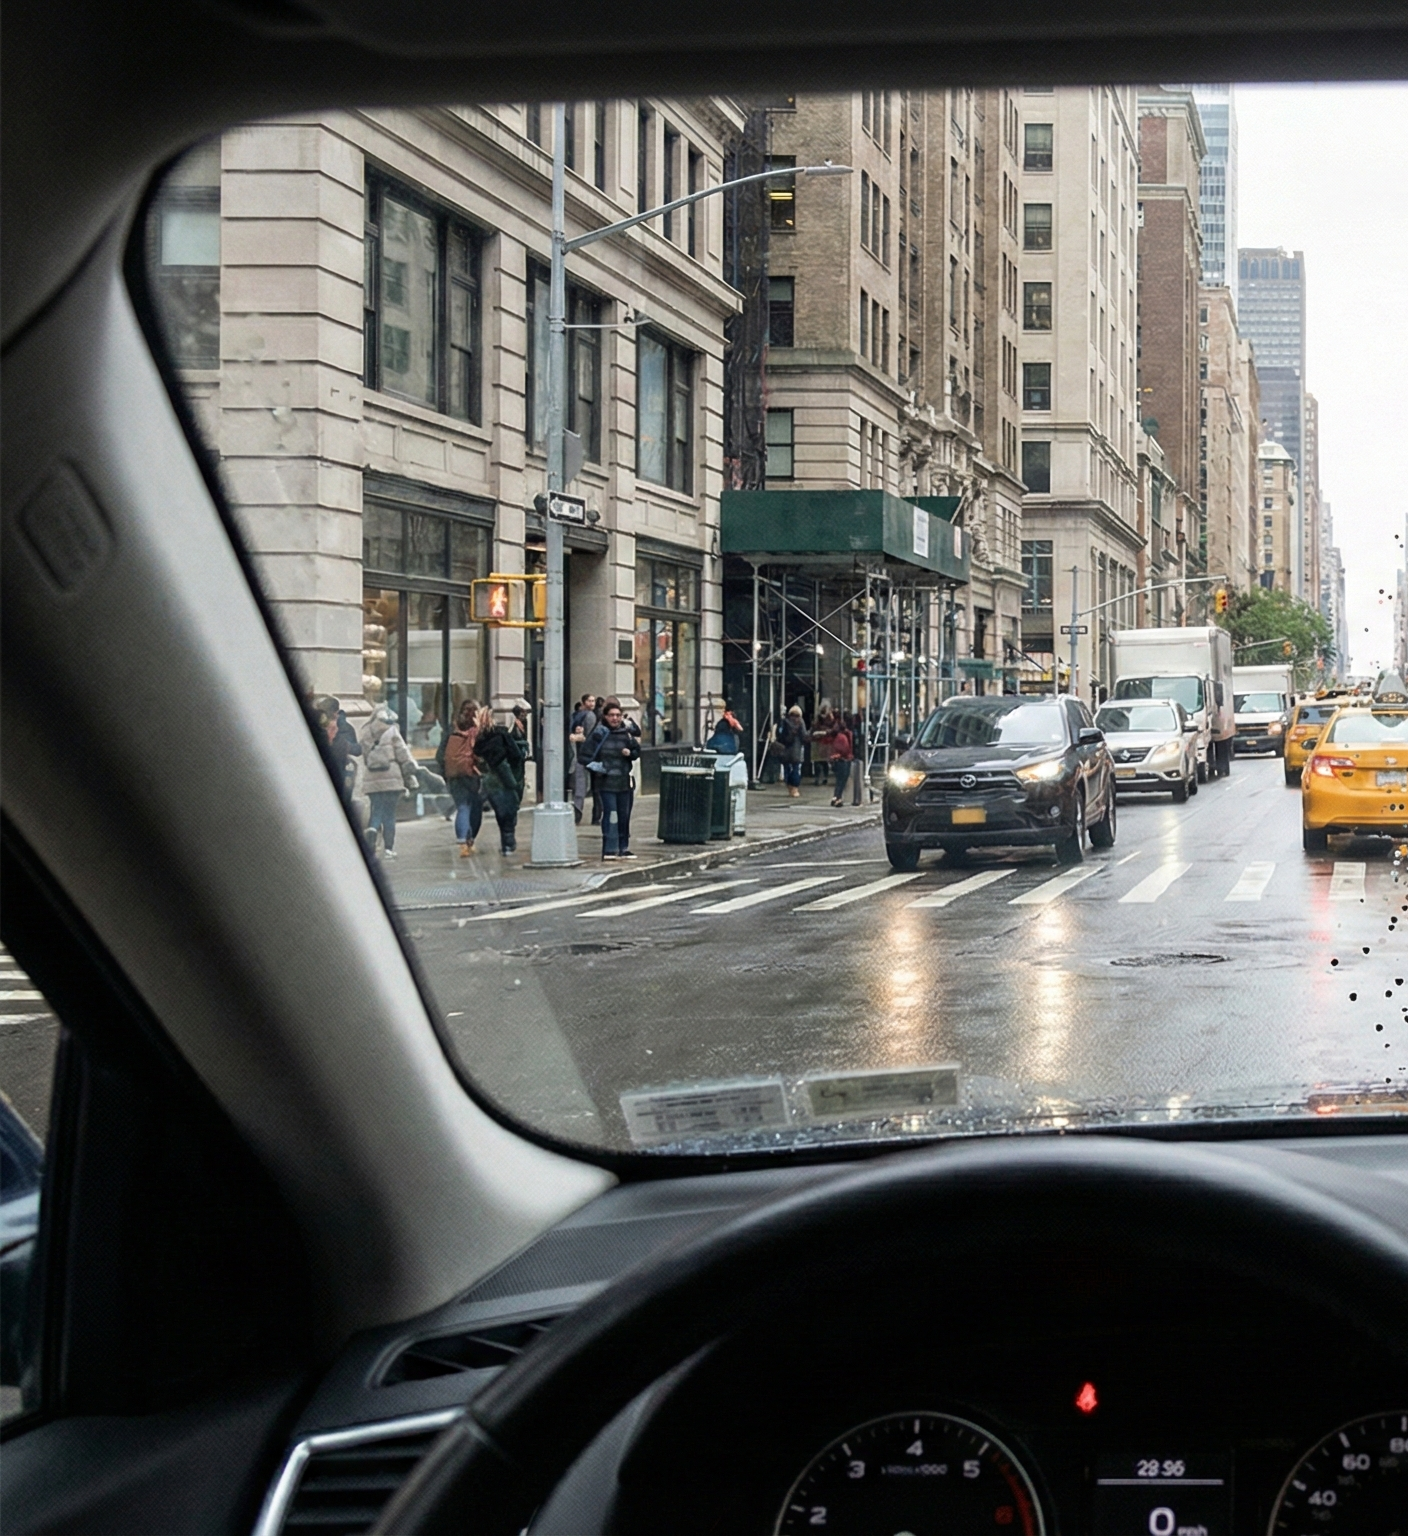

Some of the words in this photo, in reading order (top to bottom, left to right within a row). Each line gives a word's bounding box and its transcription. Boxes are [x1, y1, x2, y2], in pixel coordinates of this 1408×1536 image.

[906, 1440, 923, 1456] 4
[849, 1461, 865, 1478] 3
[964, 1460, 980, 1478] 5
[1343, 1454, 1370, 1470] 60
[1308, 1490, 1337, 1506] 40
[810, 1507, 826, 1524] 2
[1149, 1507, 1175, 1536] 0
